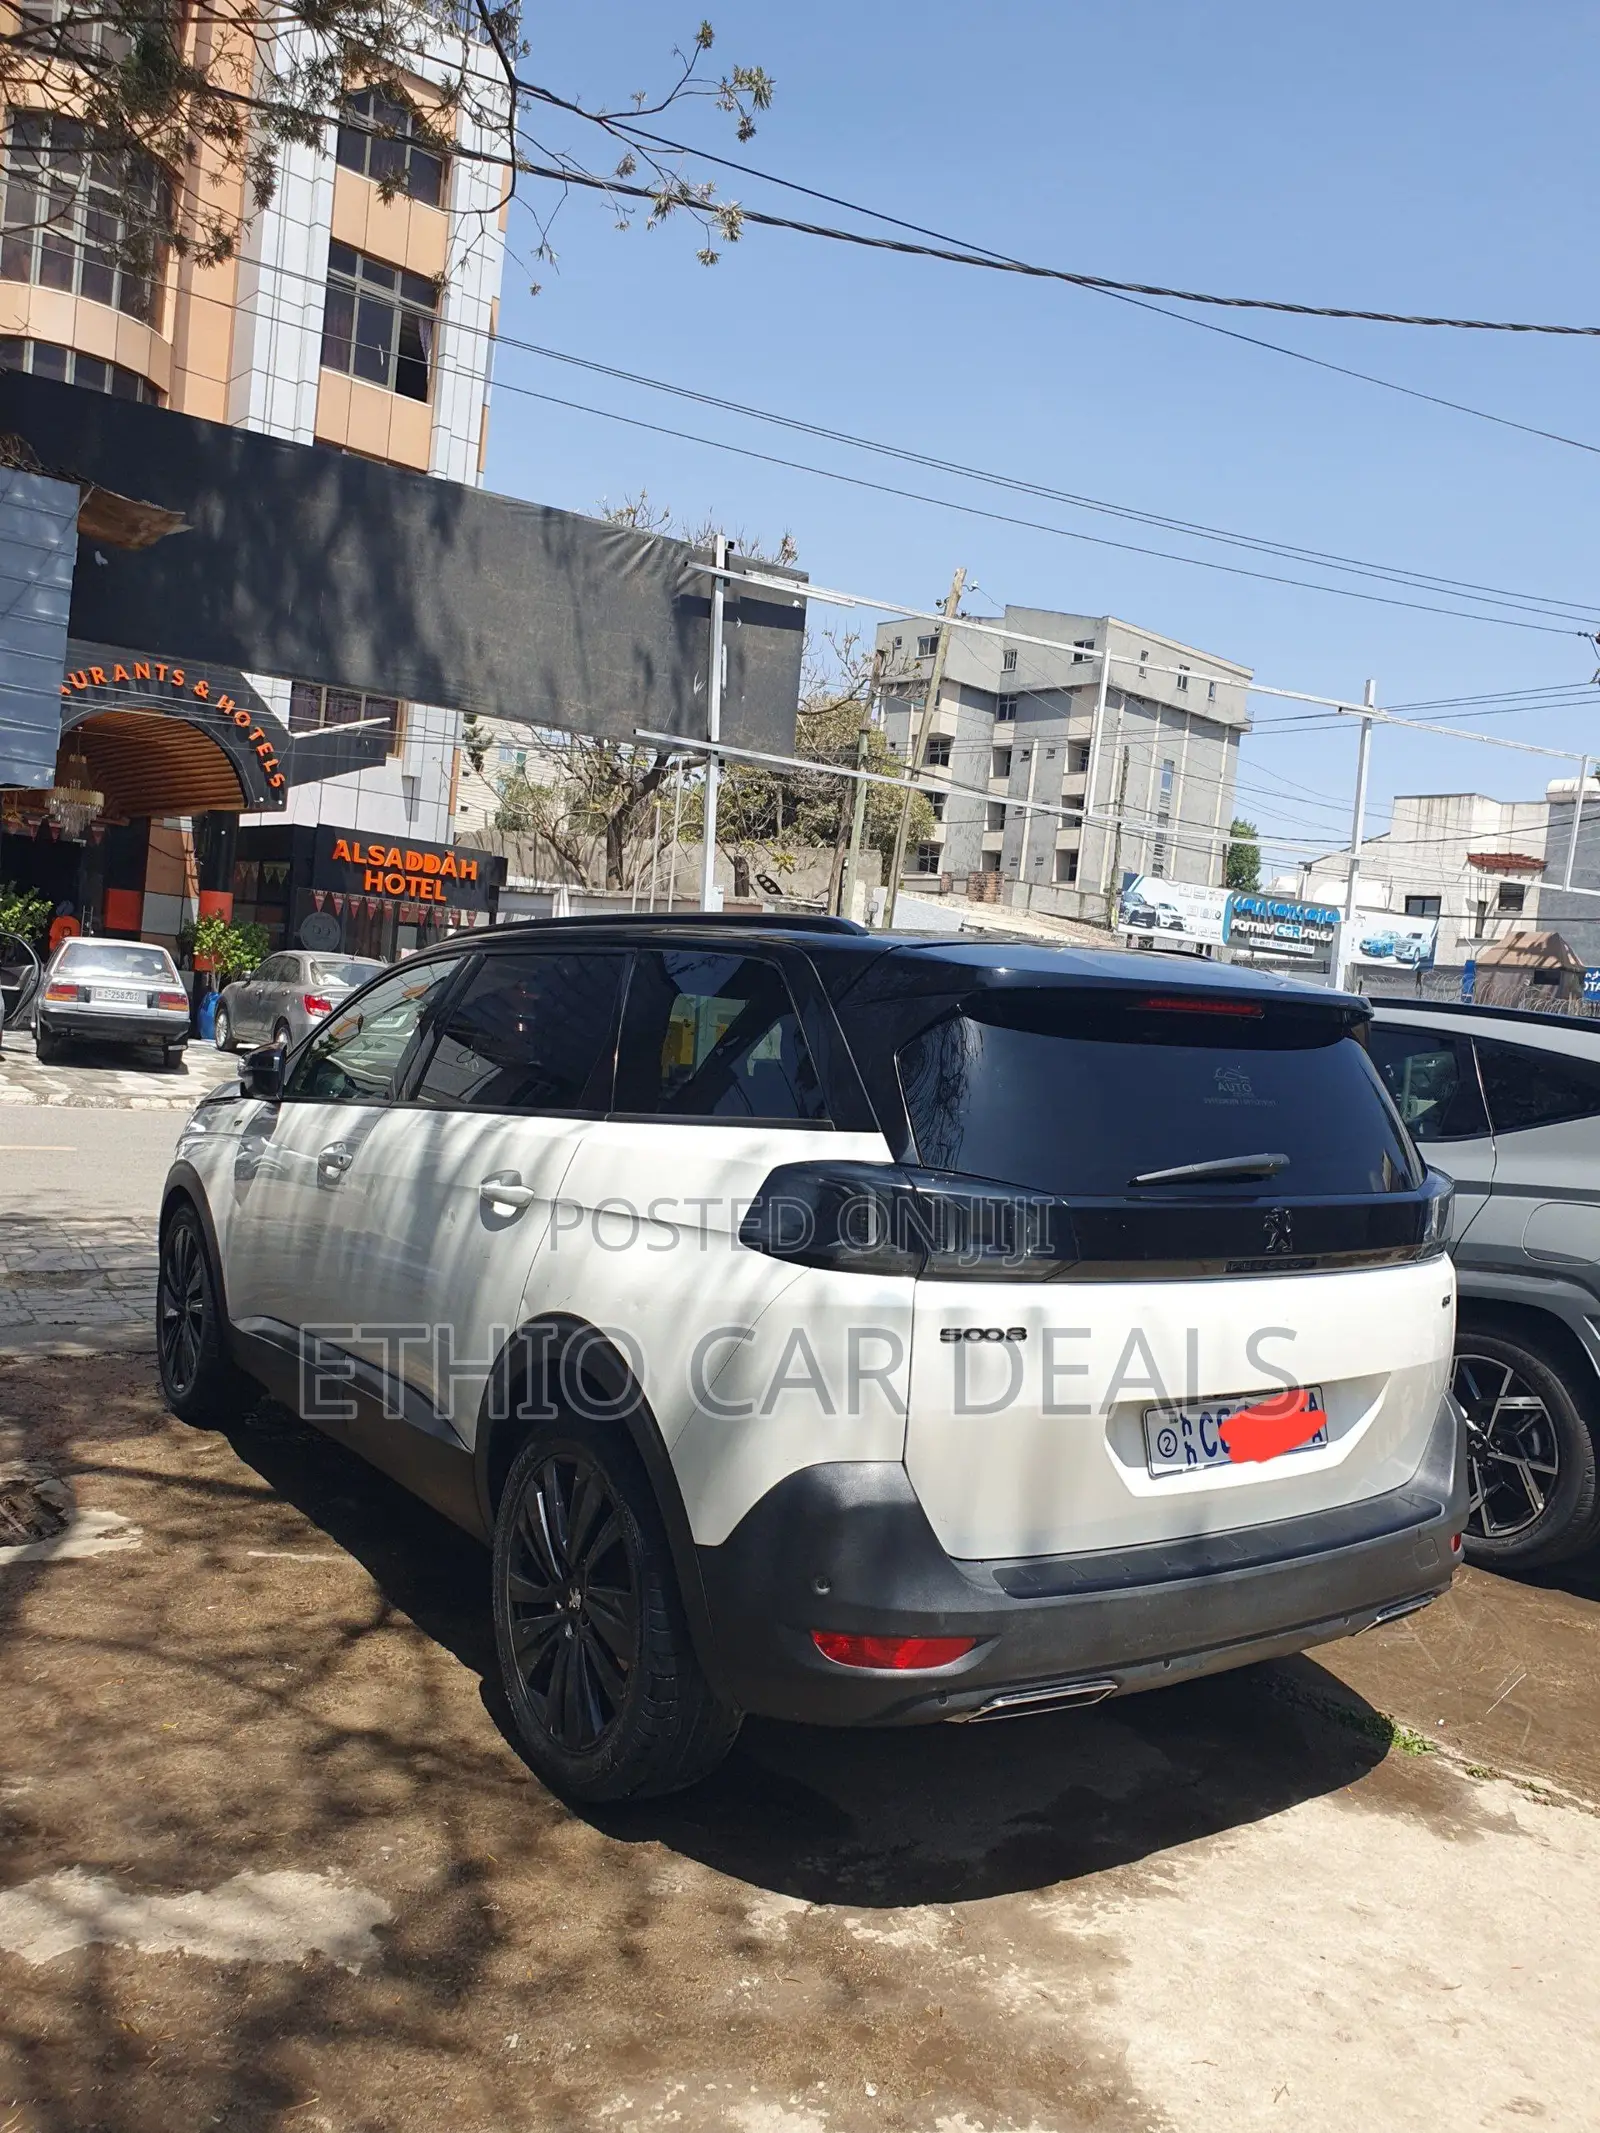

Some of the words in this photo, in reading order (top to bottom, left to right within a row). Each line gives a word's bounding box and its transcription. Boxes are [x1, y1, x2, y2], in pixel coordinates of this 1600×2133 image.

[193, 680, 210, 700] &
[215, 694, 286, 789] HOTELS
[364, 869, 447, 902] HOTEL
[940, 1327, 1027, 1343] 5008
